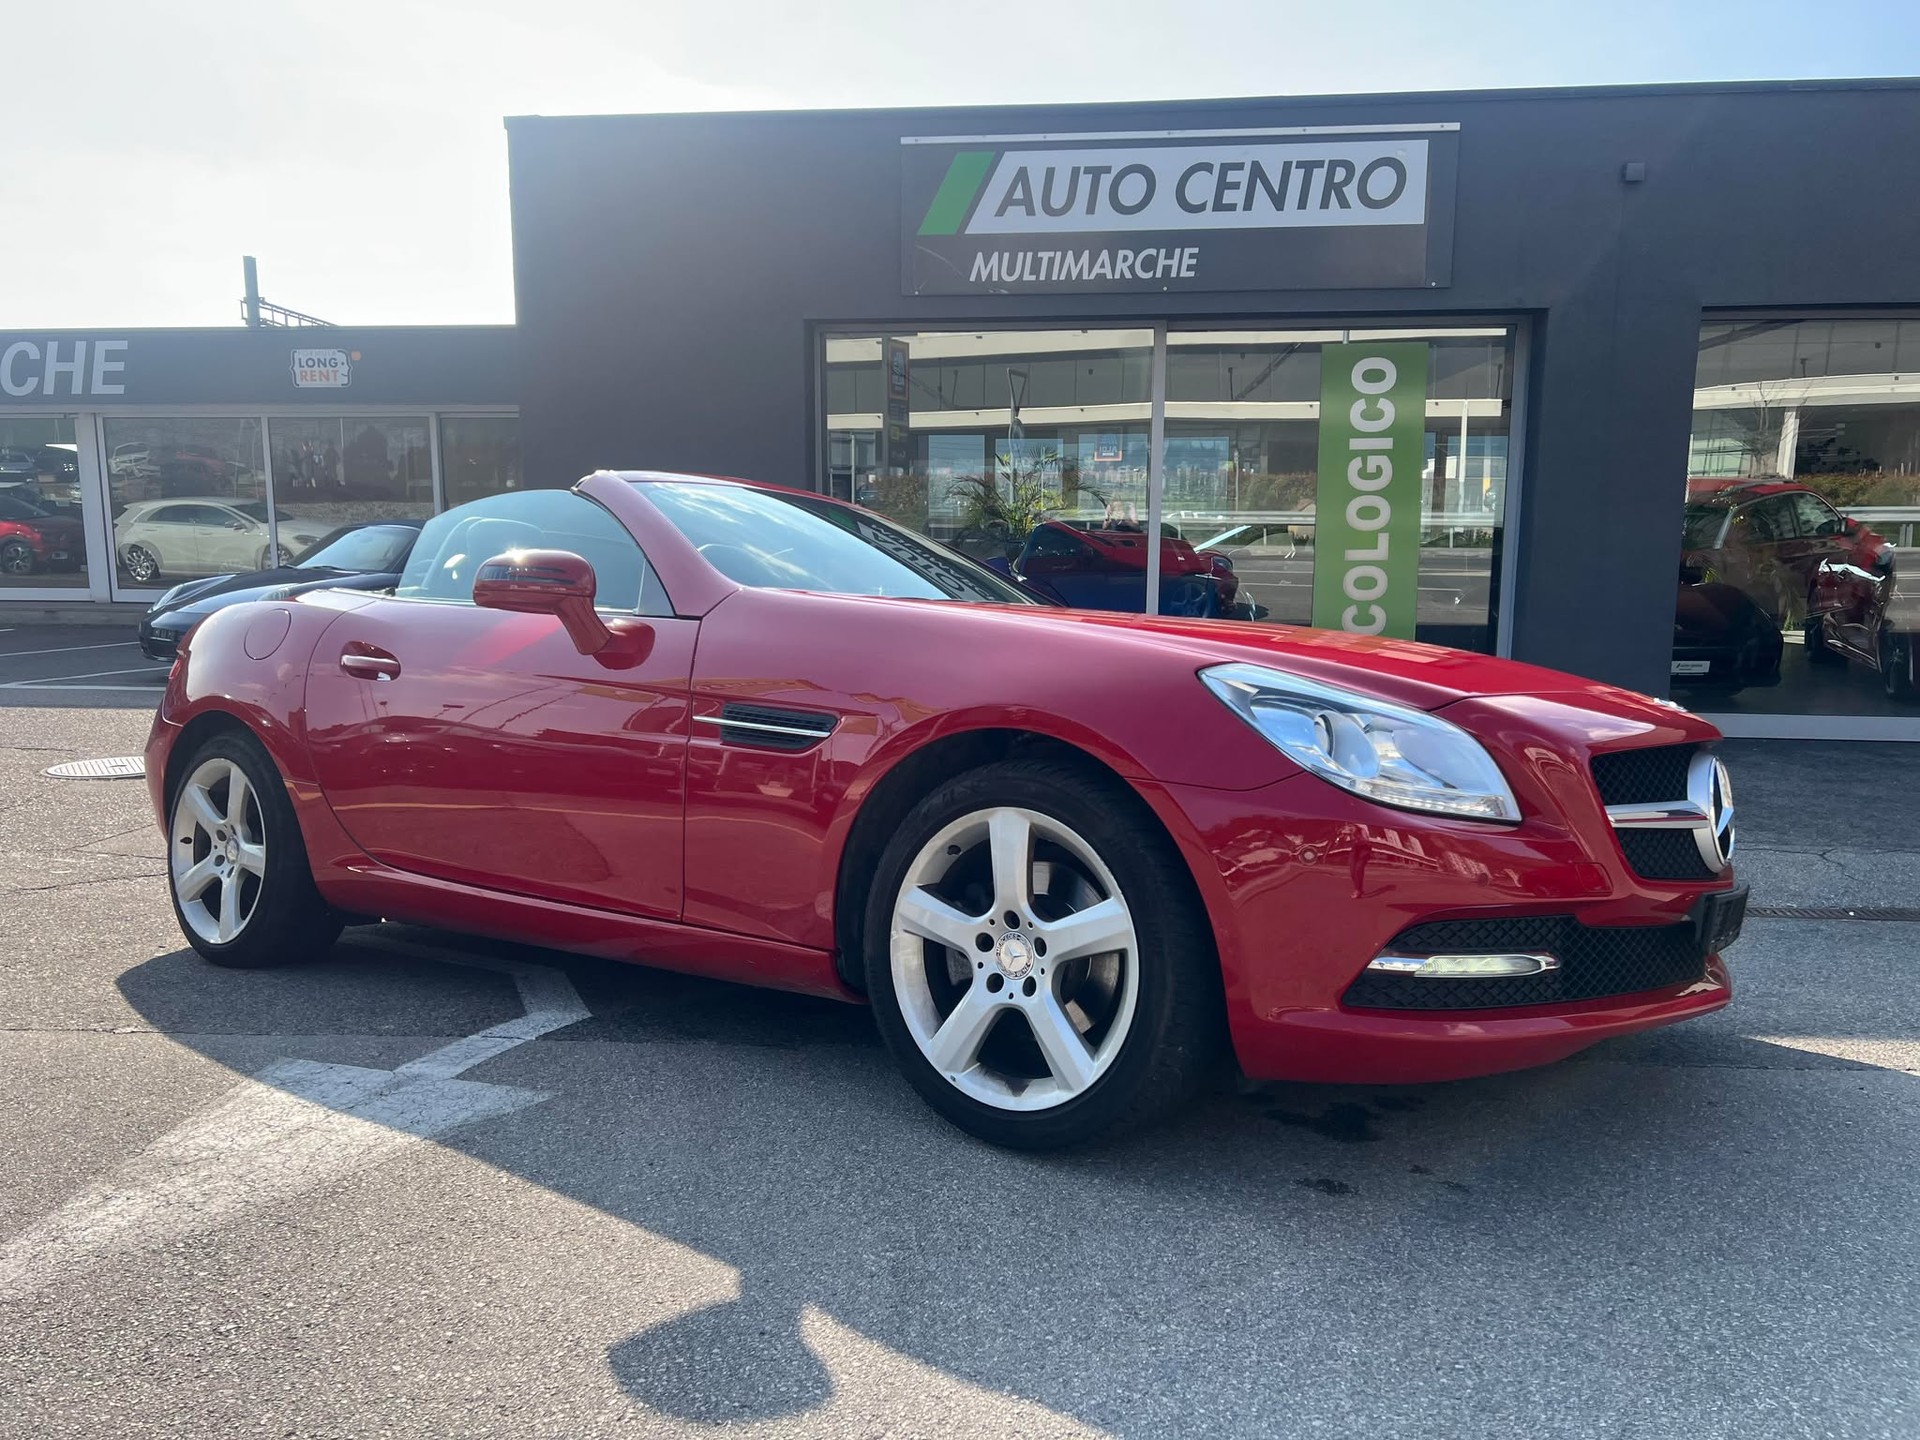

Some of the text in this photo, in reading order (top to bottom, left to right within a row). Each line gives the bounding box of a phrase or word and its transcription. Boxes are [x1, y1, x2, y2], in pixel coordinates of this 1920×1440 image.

[994, 156, 1408, 217] AUTO CENTRO
[969, 247, 1199, 282] MULTIMARCHE
[0, 340, 128, 396] CHE
[298, 357, 338, 368] LONG
[300, 369, 339, 382] RENT
